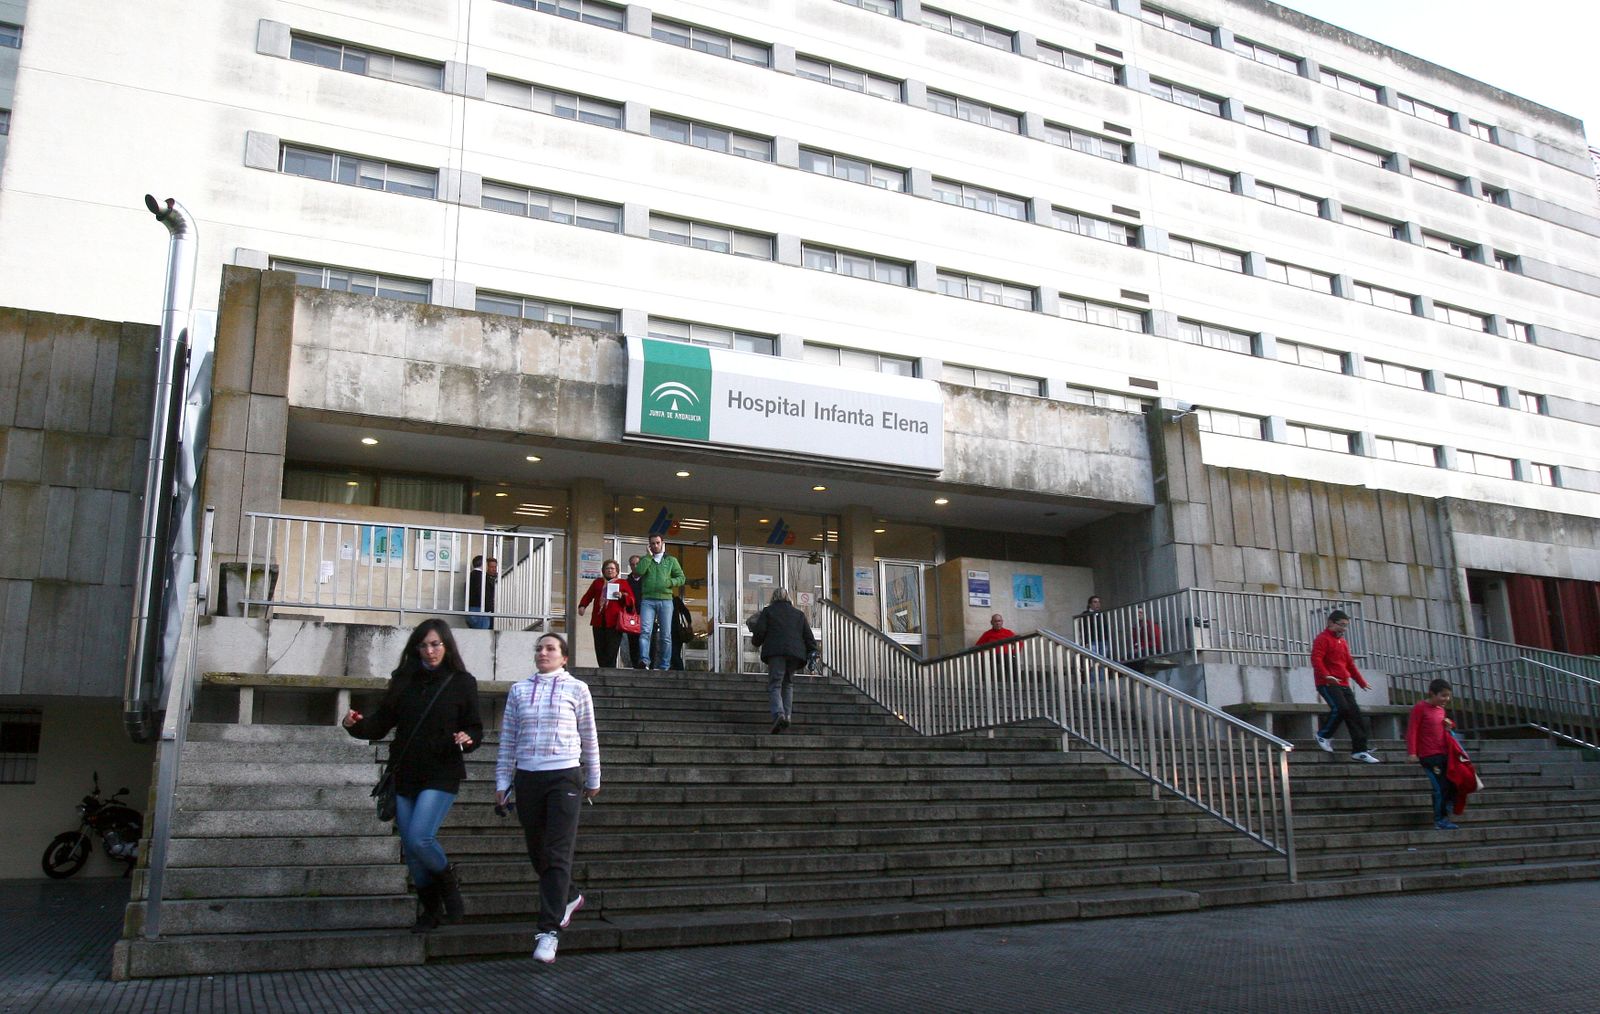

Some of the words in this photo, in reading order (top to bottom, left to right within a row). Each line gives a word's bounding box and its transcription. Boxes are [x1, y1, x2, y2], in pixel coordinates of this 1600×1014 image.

[728, 389, 805, 417] Hospital
[815, 401, 874, 427] Infanta
[882, 411, 929, 434] Elena
